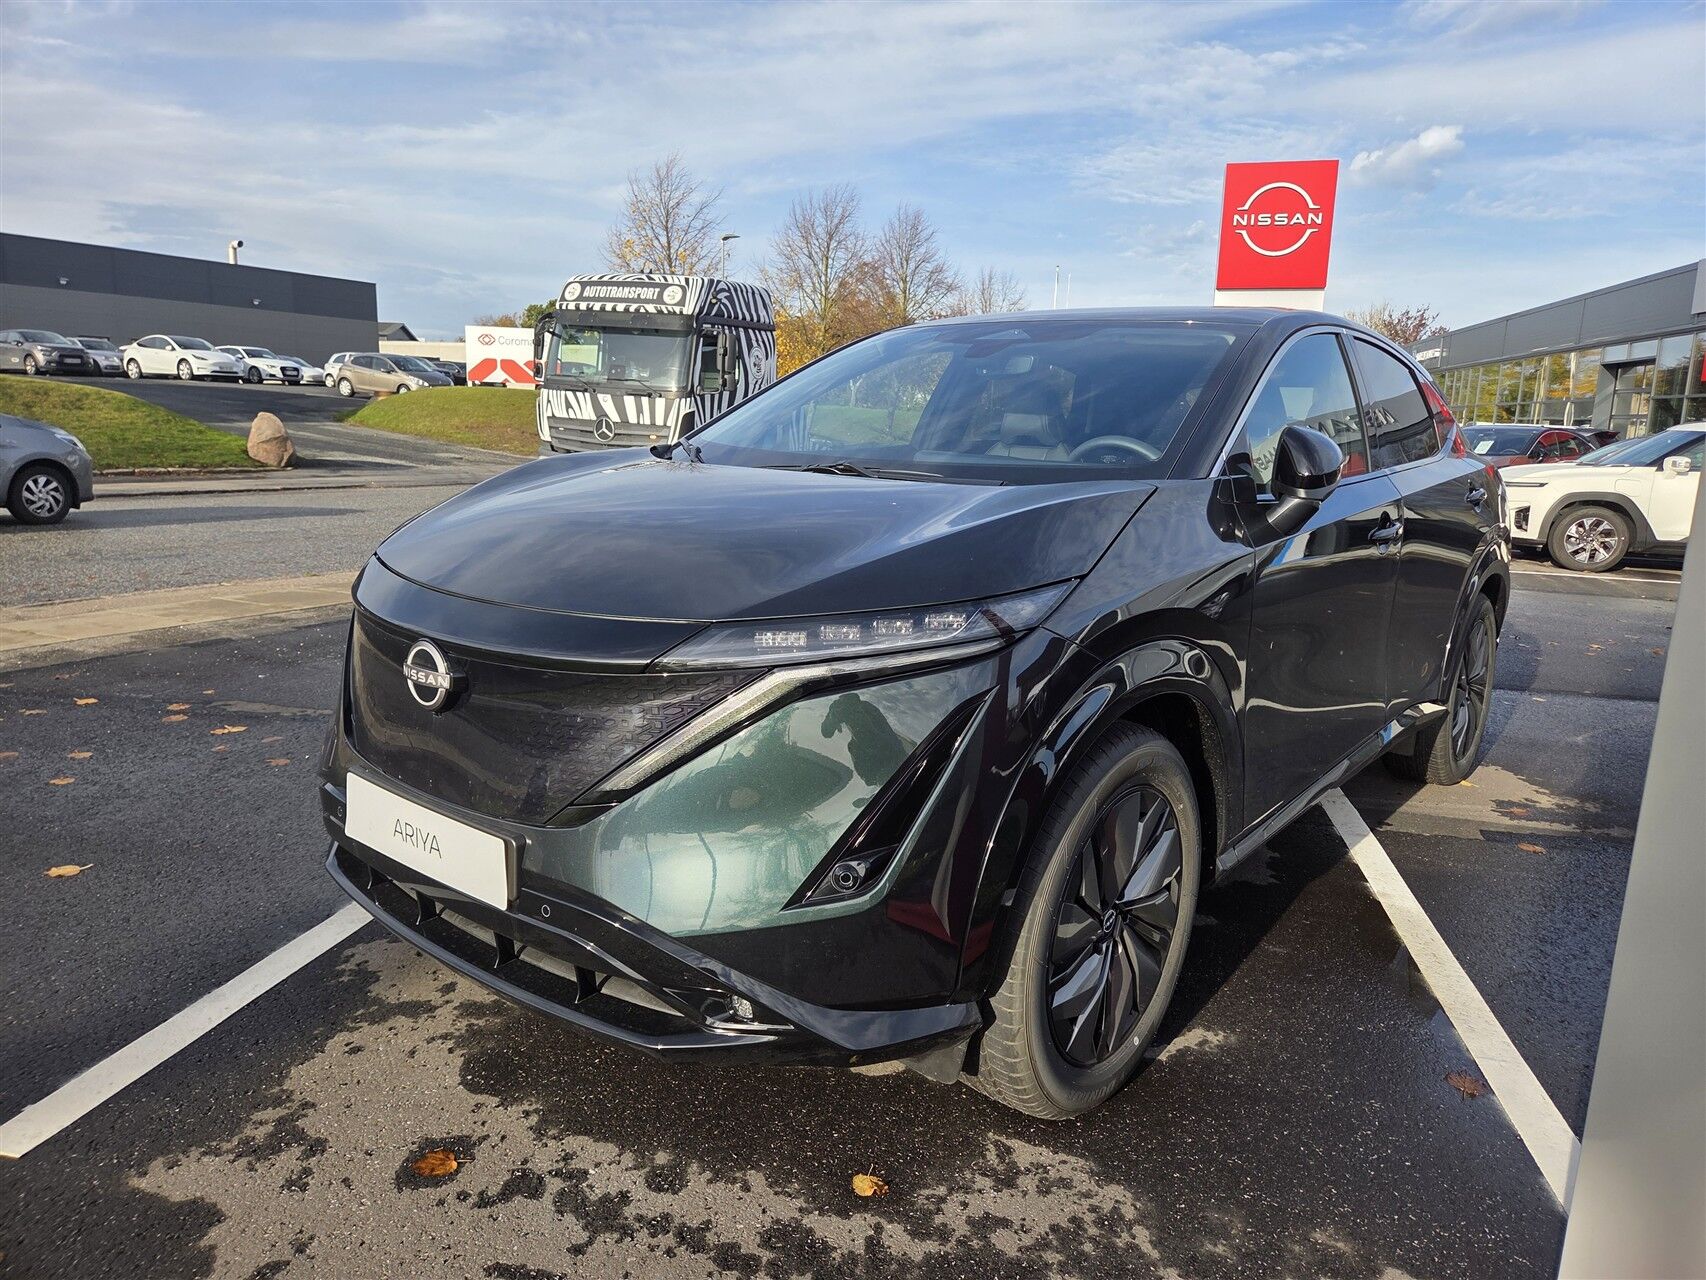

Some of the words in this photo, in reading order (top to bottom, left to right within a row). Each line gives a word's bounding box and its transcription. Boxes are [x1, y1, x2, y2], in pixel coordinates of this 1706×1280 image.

[1233, 212, 1322, 226] NISSAN
[583, 285, 660, 300] AUTOTRANSPORT
[403, 662, 449, 689] NISSAN
[393, 818, 442, 859] ARIYA
